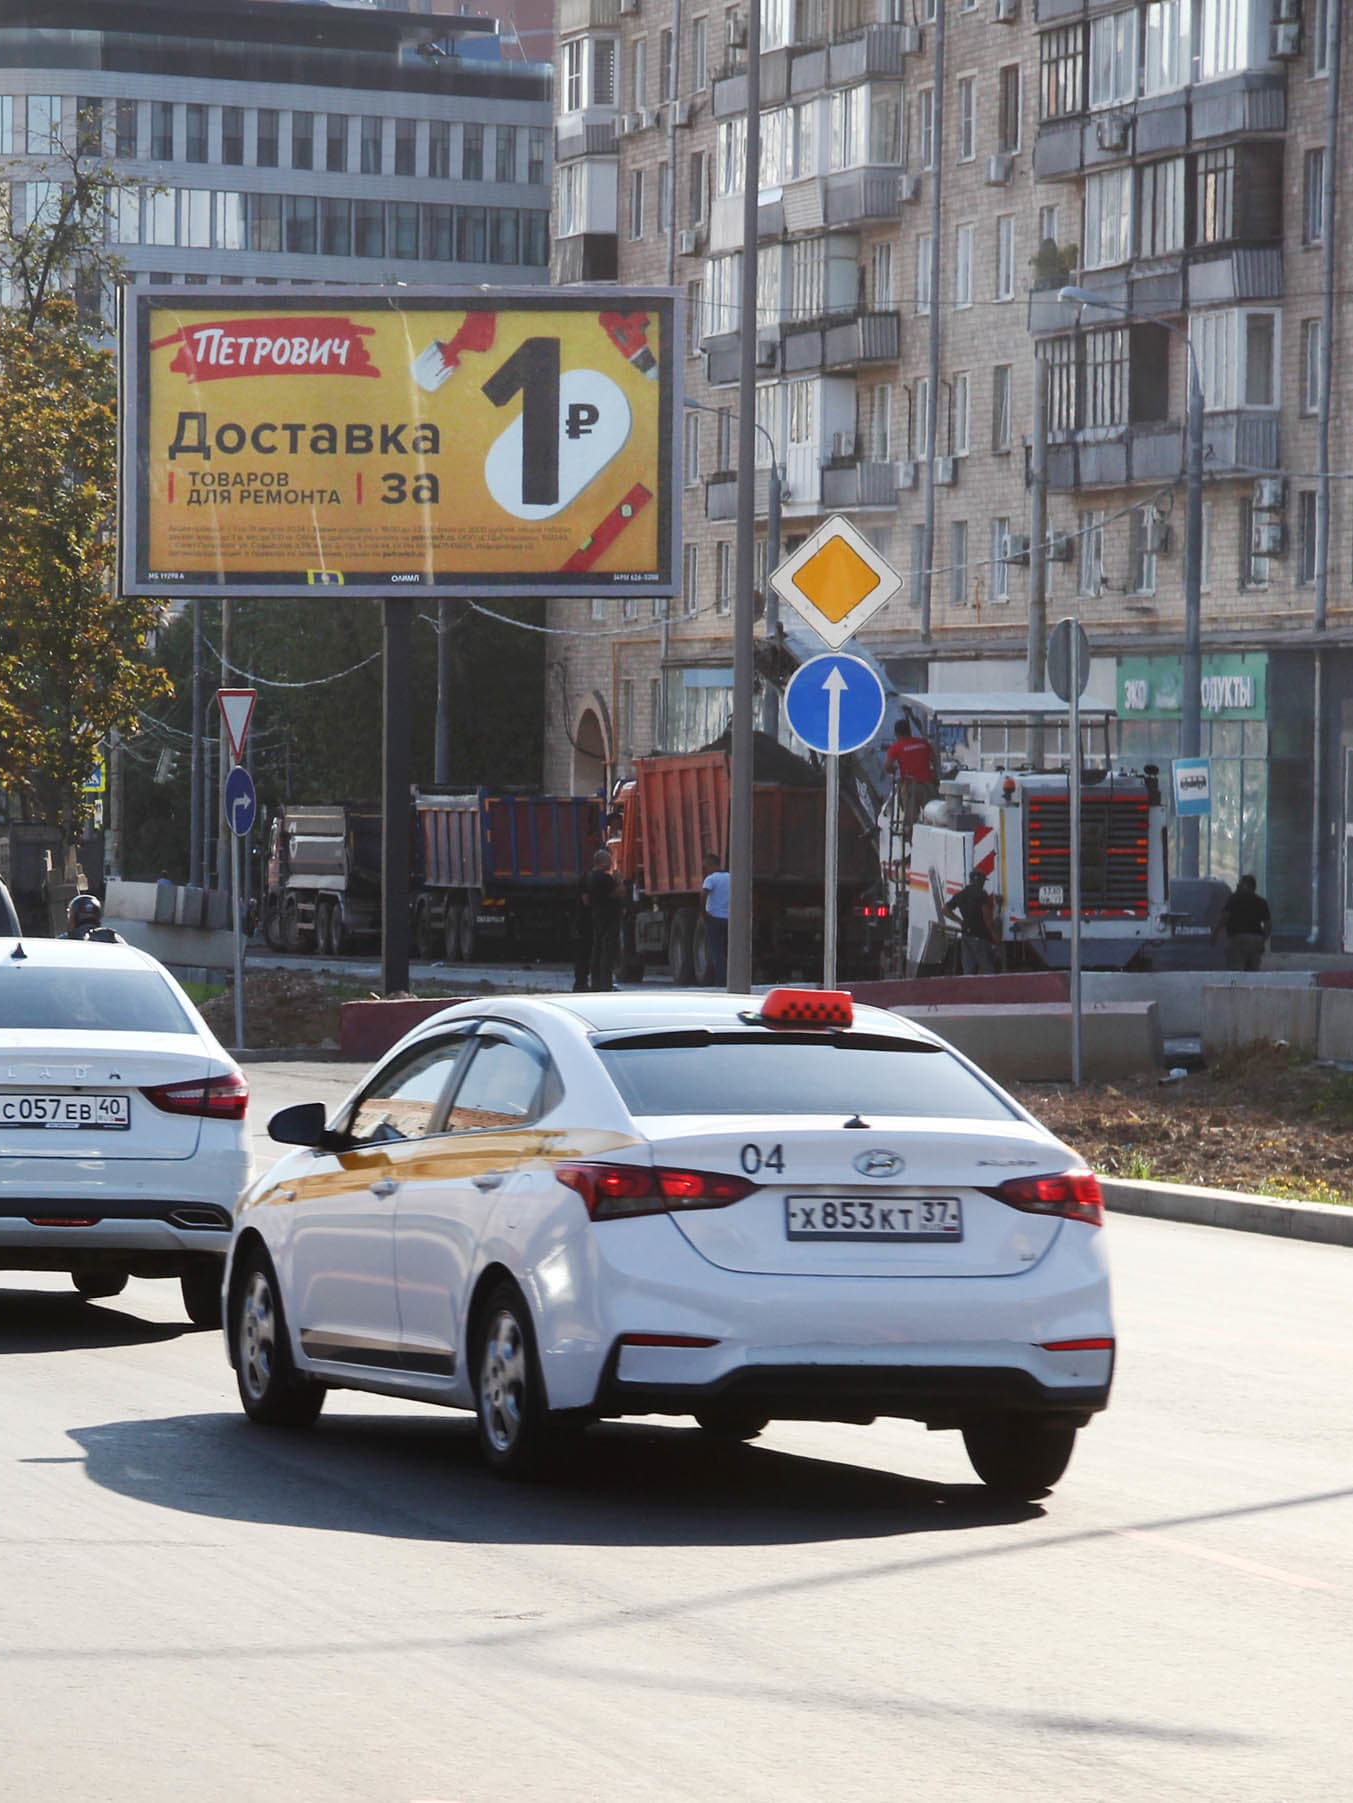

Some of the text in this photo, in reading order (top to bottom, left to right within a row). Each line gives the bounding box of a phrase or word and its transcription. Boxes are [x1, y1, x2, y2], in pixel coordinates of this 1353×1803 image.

[481, 336, 561, 504] 1
[168, 411, 440, 461] Доставка
[188, 472, 289, 487] ТОВАРОВ
[381, 472, 439, 504] за
[186, 489, 341, 505] ДЛЯ РЕМОНТА
[1124, 676, 1251, 712] ЭКО ОДУКТЫ
[8, 1065, 122, 1079] LADA
[98, 1099, 121, 1115] 40
[740, 1143, 785, 1175] 04
[921, 1201, 948, 1223] 37
